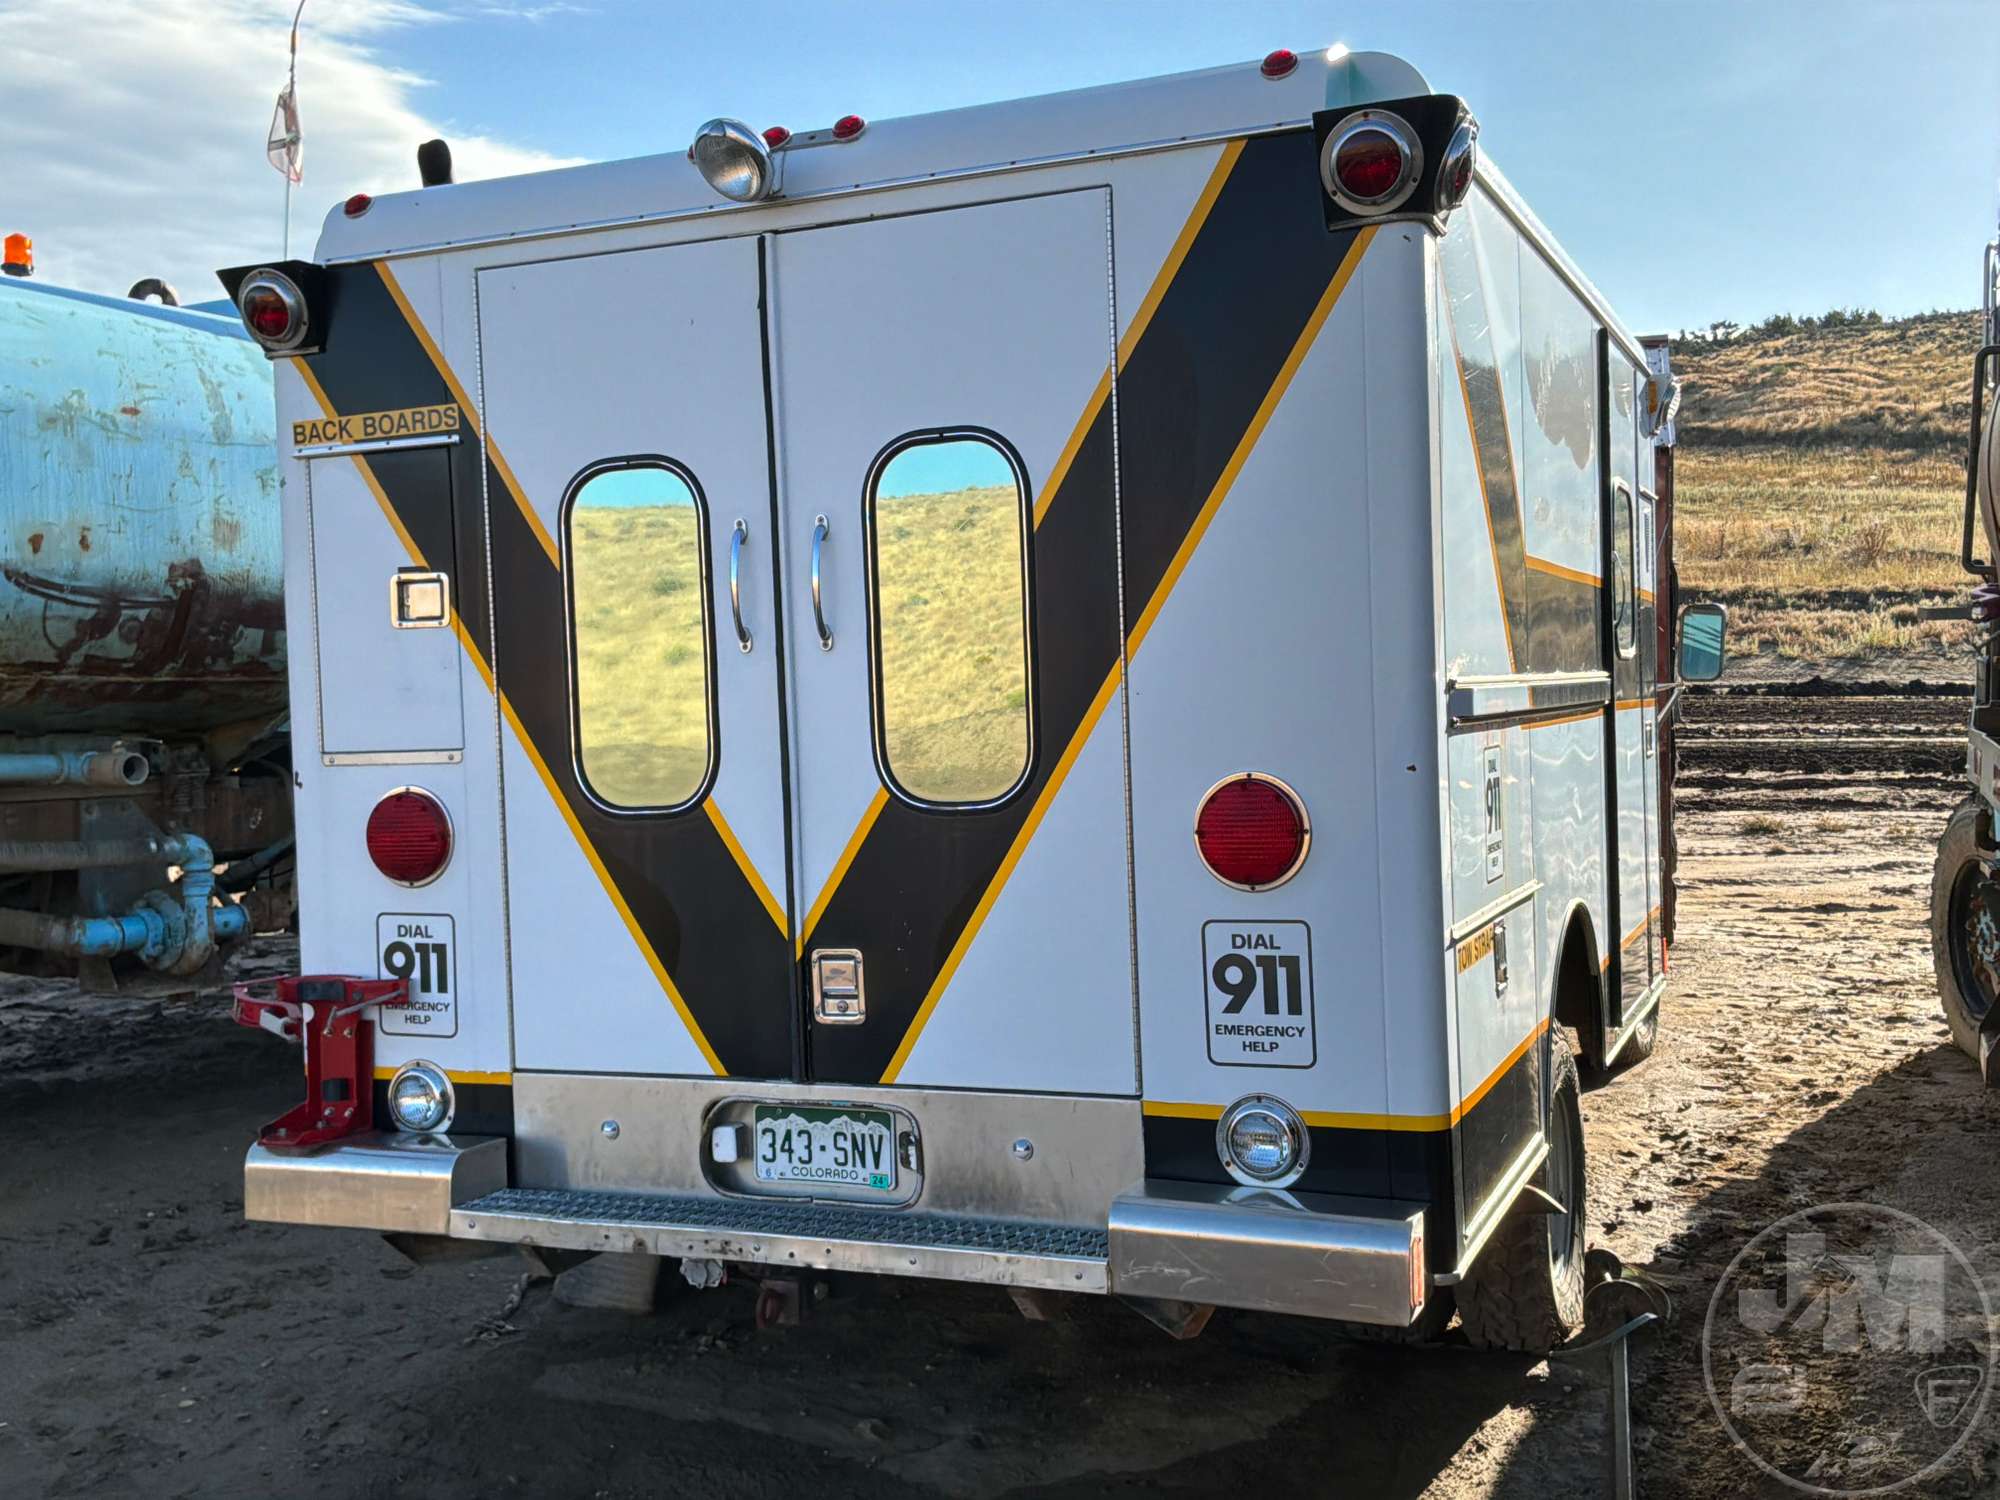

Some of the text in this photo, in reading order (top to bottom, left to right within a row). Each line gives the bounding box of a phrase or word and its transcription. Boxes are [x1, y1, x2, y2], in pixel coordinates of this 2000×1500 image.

[293, 406, 457, 444] BACK BOARDS
[397, 924, 433, 938] DIAL
[1231, 933, 1281, 950] DIAL
[1212, 953, 1303, 1016] 911
[404, 1014, 431, 1024] HELP
[1215, 1023, 1306, 1037] EMERGENCY
[1242, 1041, 1280, 1052] HELP
[791, 1166, 859, 1181] COLORADO
